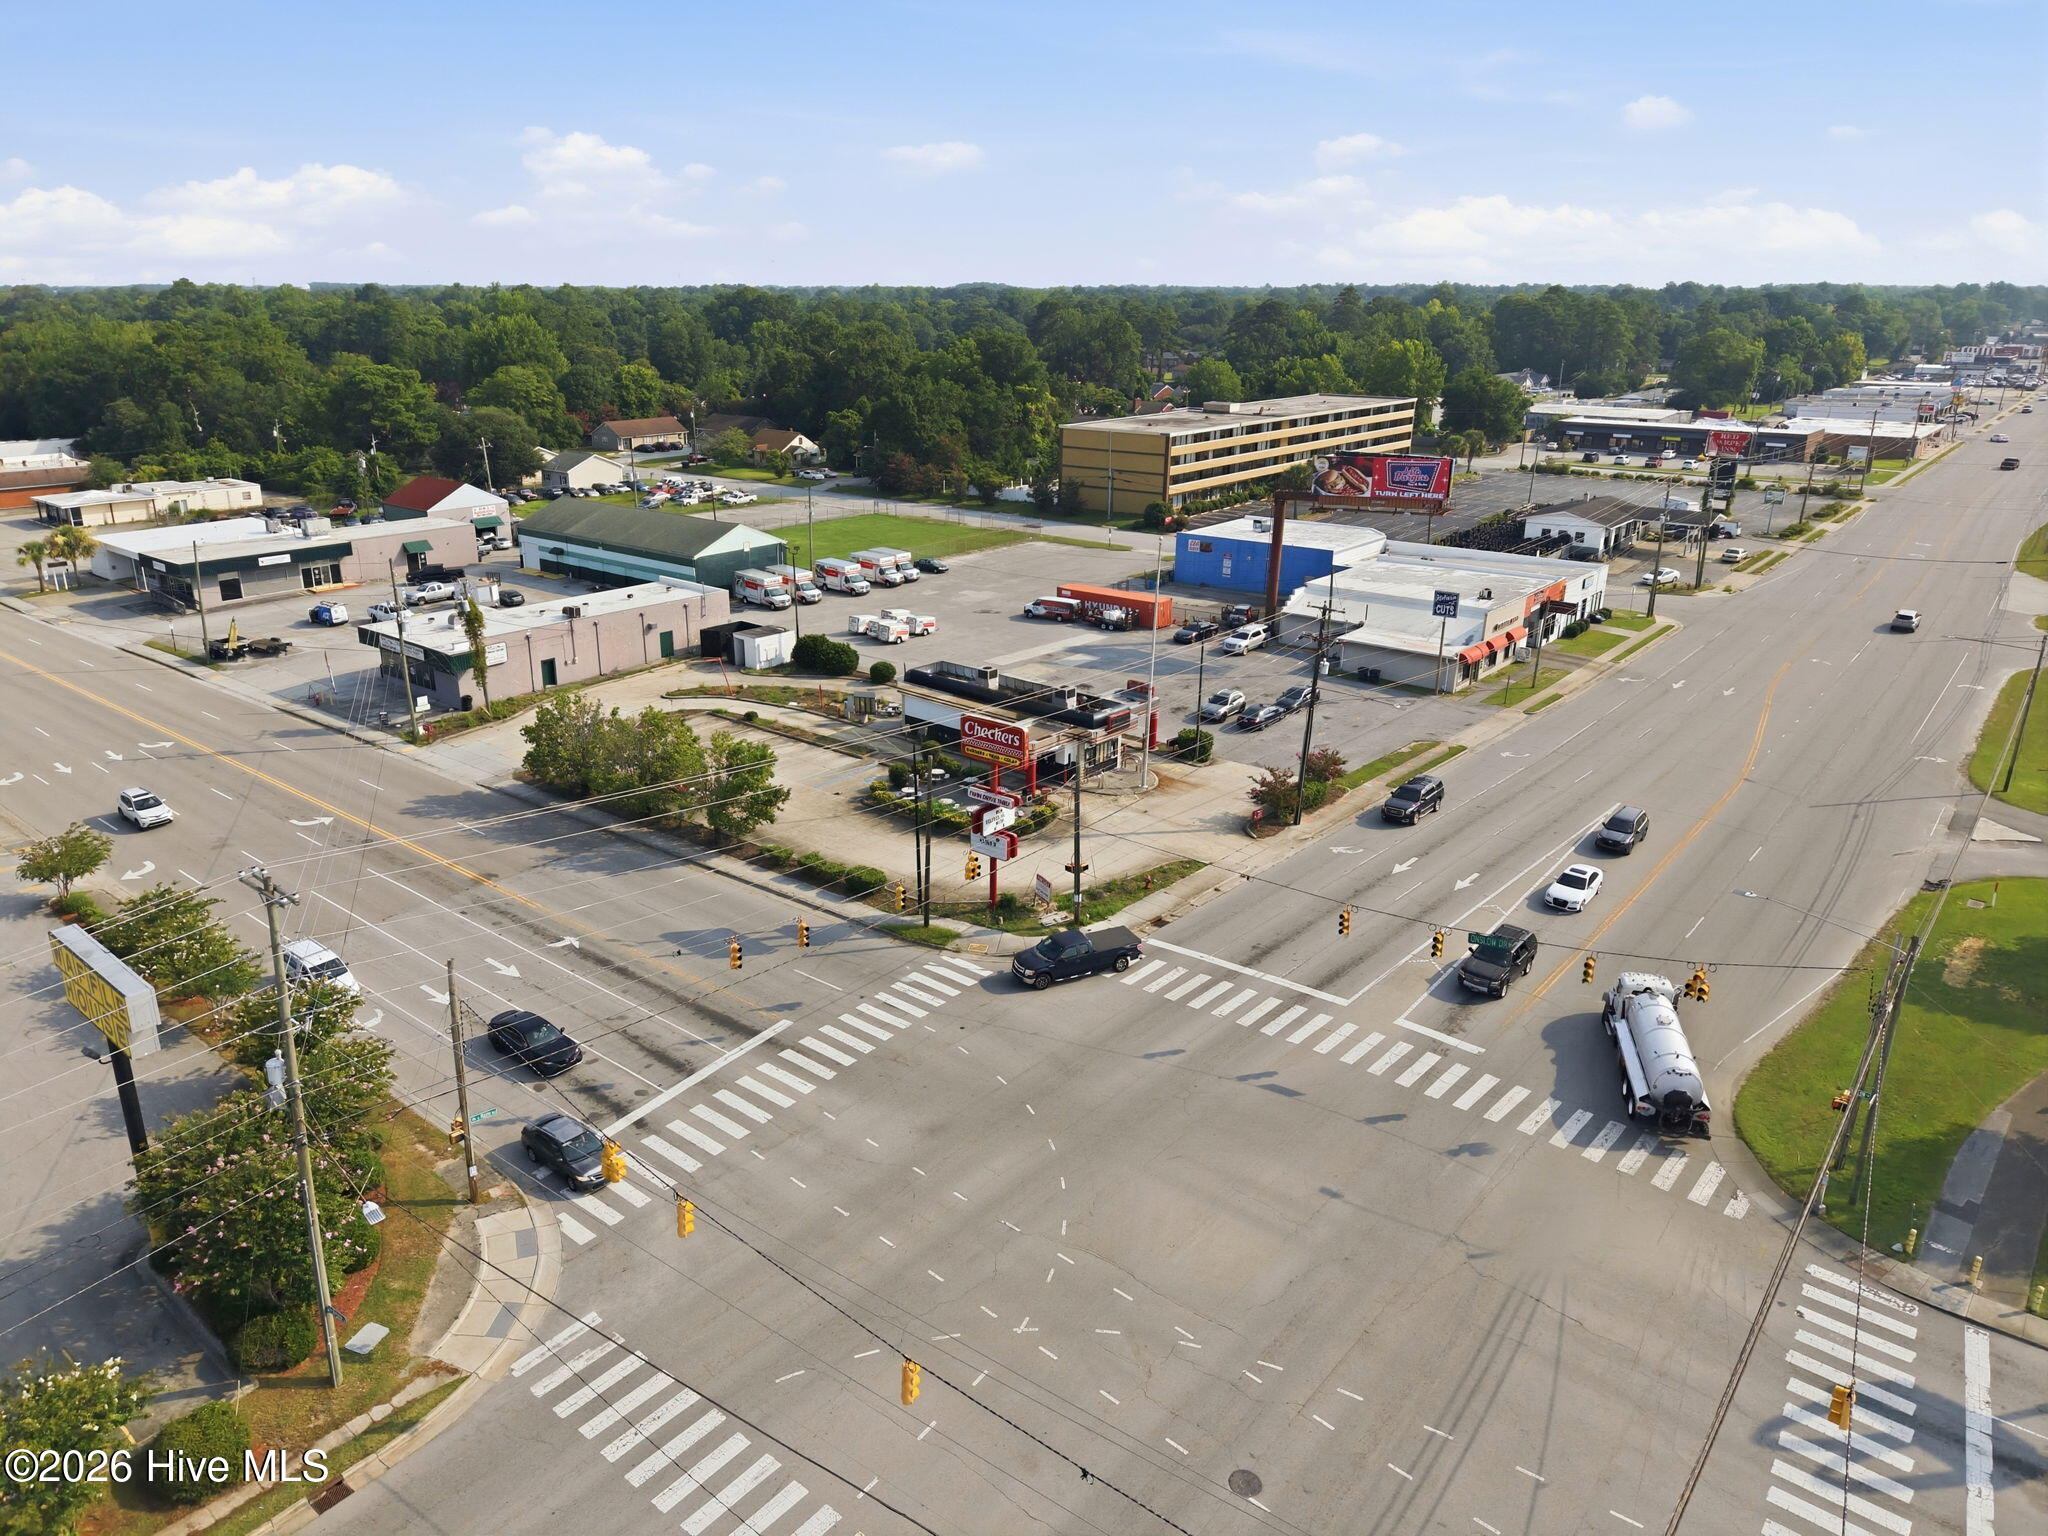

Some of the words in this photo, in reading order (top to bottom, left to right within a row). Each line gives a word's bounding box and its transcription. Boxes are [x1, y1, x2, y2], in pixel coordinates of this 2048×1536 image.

[1084, 600, 1131, 614] HYUNDA
[1435, 604, 1455, 615] CUTS
[964, 720, 1020, 747] Checkers
[1470, 934, 1497, 947] ONSLOW
